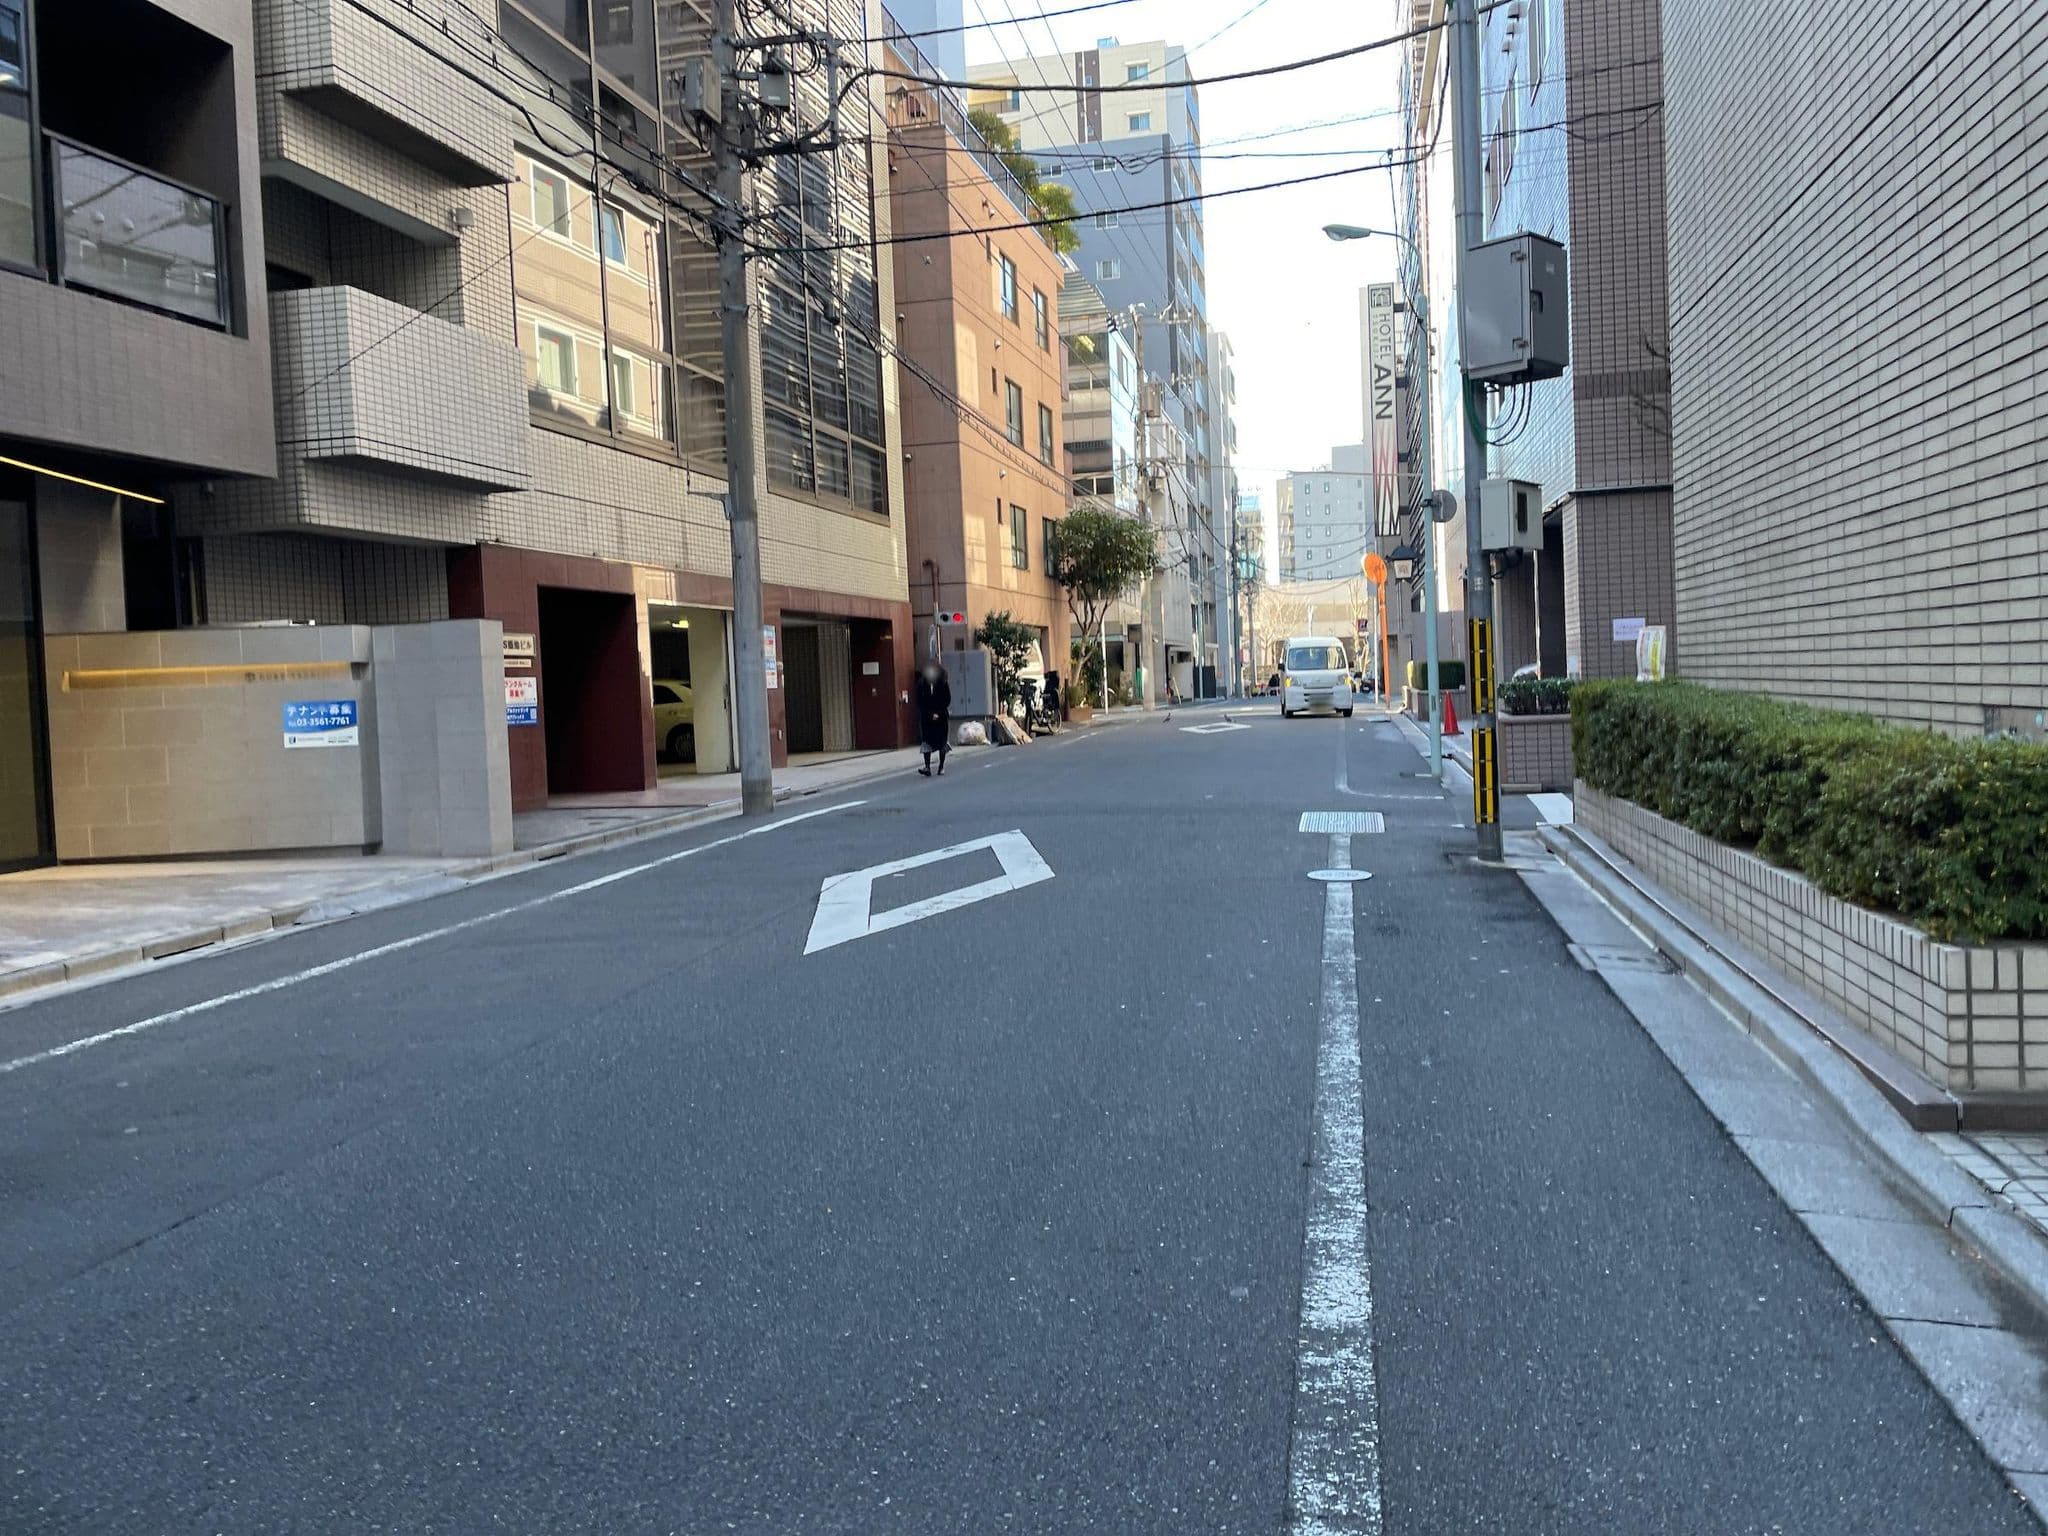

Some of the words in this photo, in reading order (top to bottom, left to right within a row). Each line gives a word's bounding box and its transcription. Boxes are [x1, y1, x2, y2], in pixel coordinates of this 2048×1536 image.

[1379, 313, 1392, 360] HOTEL
[1374, 363, 1393, 420] ANN
[287, 703, 352, 717] テナント募集
